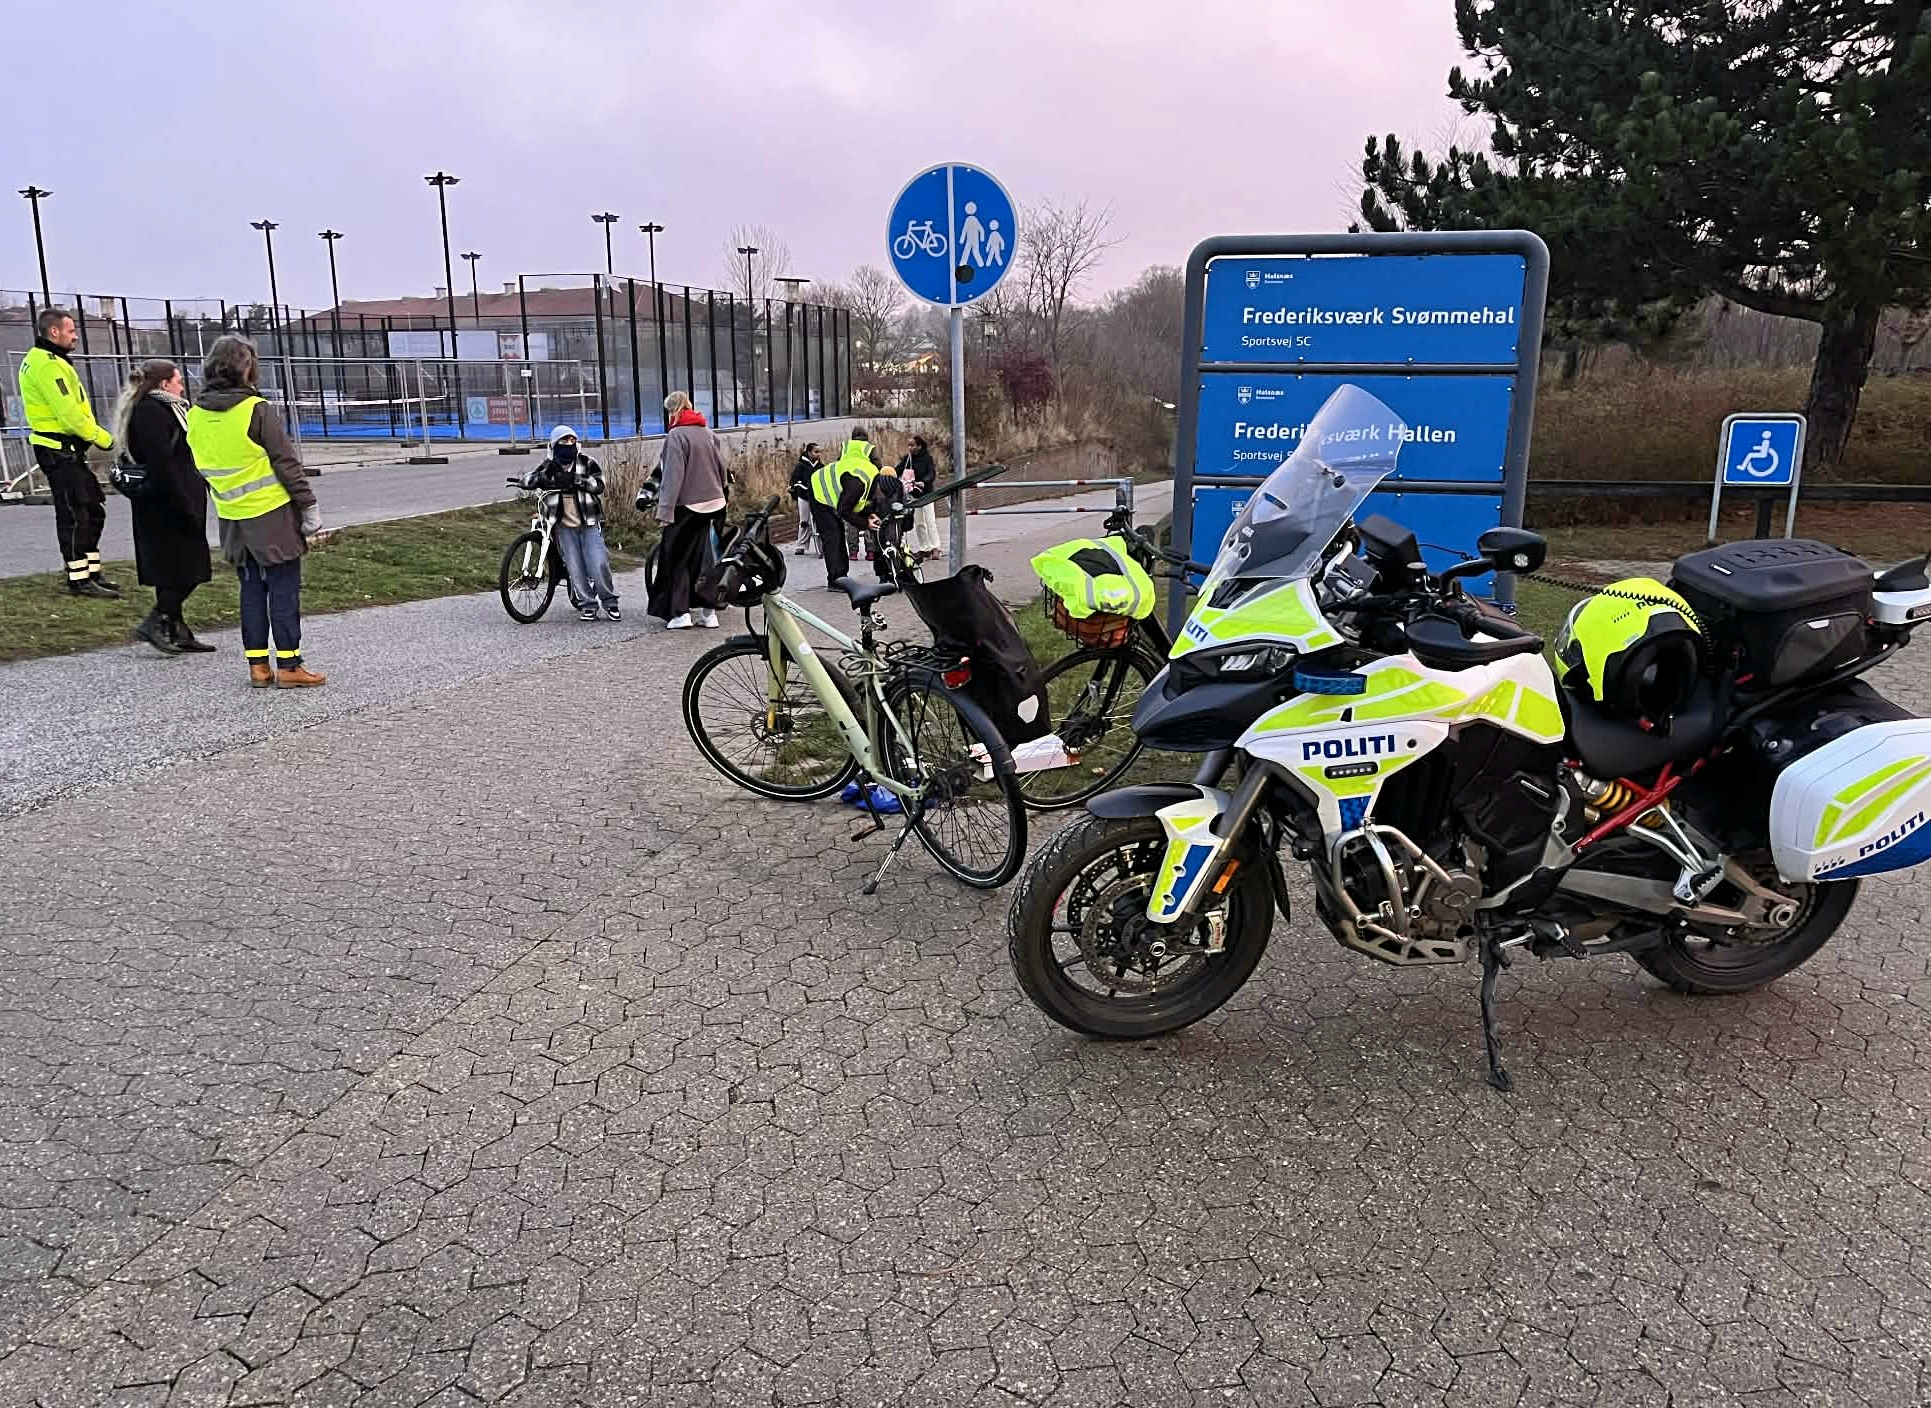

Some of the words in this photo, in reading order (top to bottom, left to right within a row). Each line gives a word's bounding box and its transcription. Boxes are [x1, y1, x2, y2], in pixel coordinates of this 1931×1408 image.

[1242, 306, 1384, 325] Frederiksværk
[1391, 306, 1515, 325] Svømmehal
[1241, 335, 1292, 347] Sportsvej
[1296, 336, 1312, 346] 5C
[1387, 423, 1456, 443] Hallen
[1233, 449, 1283, 462] Sportsvej
[1302, 734, 1395, 760] POLITI
[1859, 811, 1925, 857] POLITI
